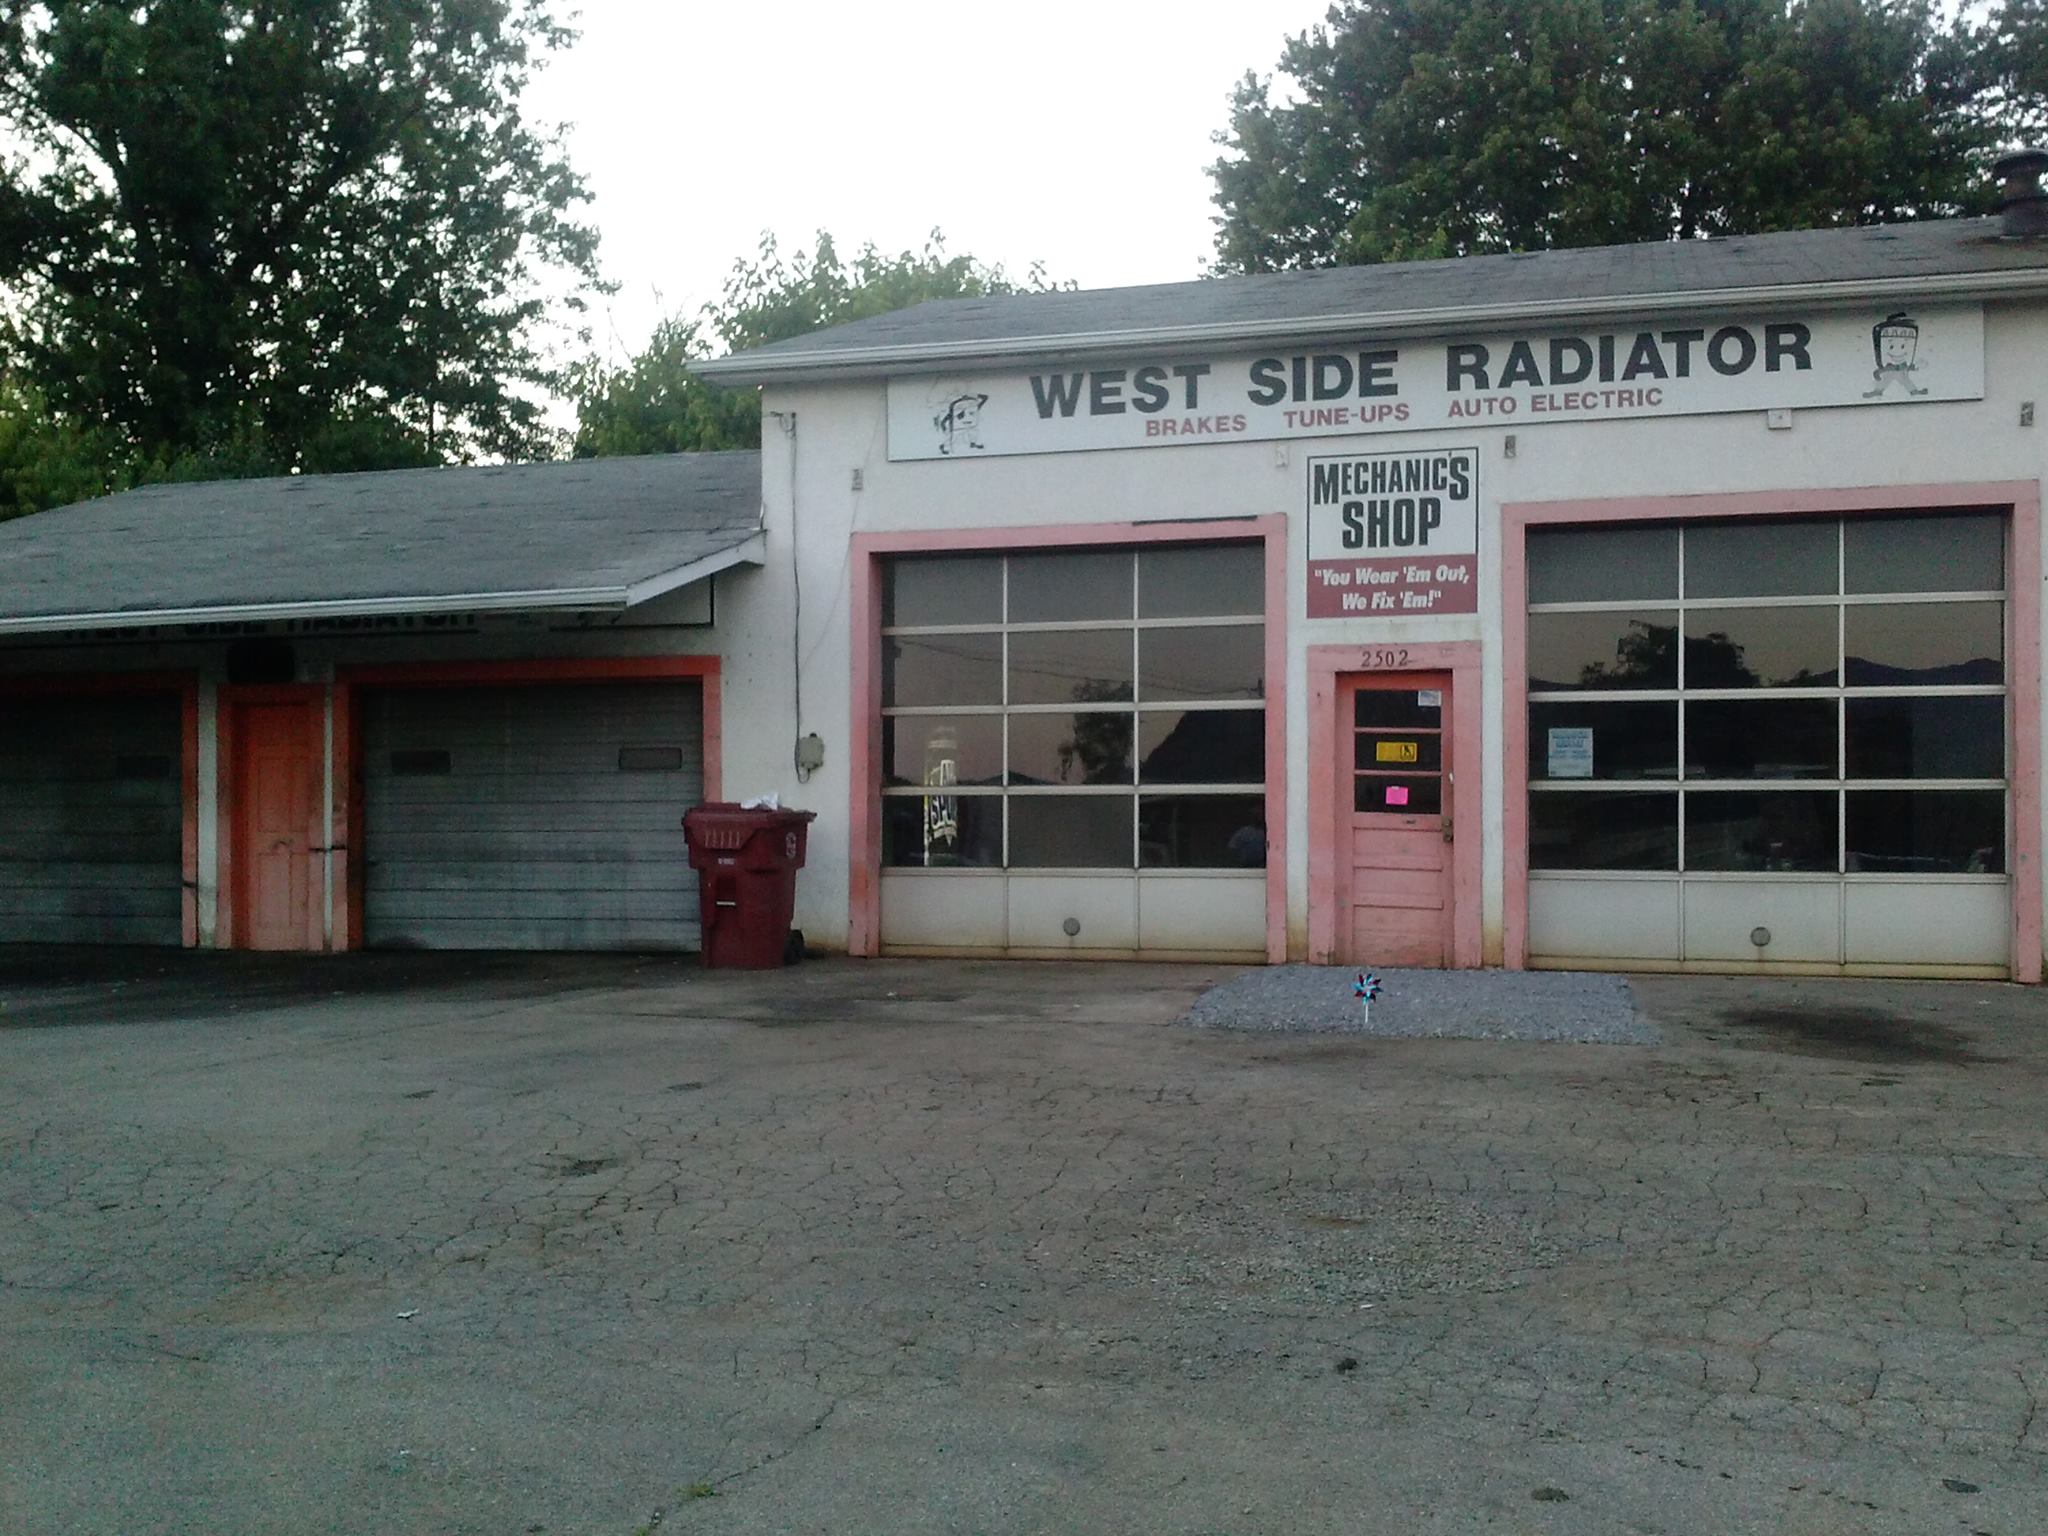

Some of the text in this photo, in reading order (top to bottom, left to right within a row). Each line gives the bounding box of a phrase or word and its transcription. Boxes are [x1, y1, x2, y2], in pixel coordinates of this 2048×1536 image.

[1030, 320, 1814, 419] WEST SIDE RADIATOR
[1146, 387, 1665, 438] BRAKES TUNE-UPS AUTO ELECTRIC
[1313, 451, 1470, 505] MECHANIC'S
[1342, 497, 1441, 549] SHOP
[1355, 568, 1399, 585] Wear
[1403, 565, 1431, 583] 'Em
[1435, 564, 1470, 585] Out,
[1342, 593, 1367, 611] We
[1371, 591, 1395, 610] Fix
[1361, 649, 1409, 668] 2502
